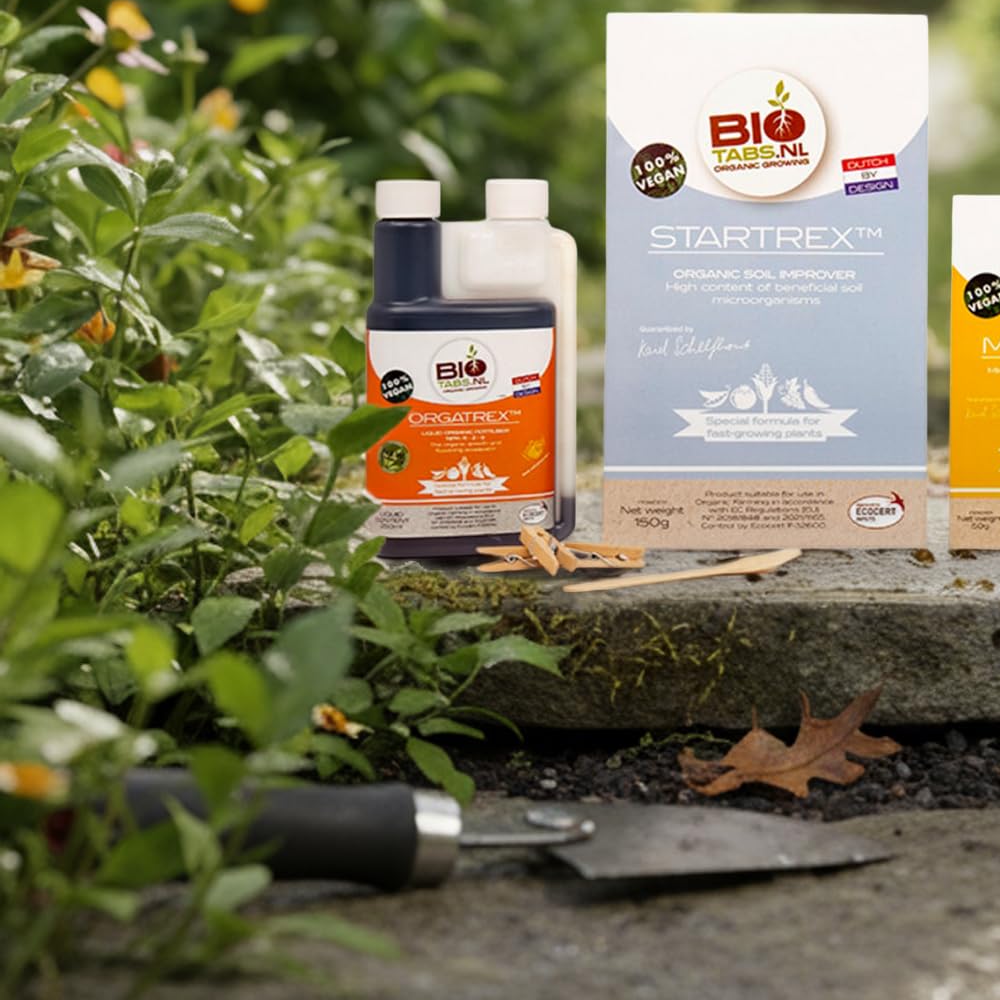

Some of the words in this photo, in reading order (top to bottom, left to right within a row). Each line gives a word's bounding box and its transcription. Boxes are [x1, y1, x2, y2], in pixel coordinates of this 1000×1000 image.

[709, 109, 805, 147] BIO
[712, 143, 808, 163] TABS.NL
[634, 151, 679, 173] 100%
[713, 163, 760, 172] ORGANIC
[762, 159, 809, 169] GROWING
[846, 157, 888, 169] DUTCH
[636, 164, 685, 191] VEGAN
[861, 171, 877, 179] BY
[848, 180, 894, 193] DESIGN
[673, 270, 741, 279] ORGANIC
[744, 270, 775, 279] SOIL
[780, 270, 856, 279] IMPROVER
[665, 282, 697, 293] High
[701, 284, 753, 293] content
[756, 282, 771, 293] of
[775, 282, 837, 293] beneficial
[841, 283, 862, 293] soil
[712, 295, 820, 306] microorganisms
[436, 359, 487, 381] BIO
[383, 383, 413, 399] VEGAN
[706, 416, 750, 427] Special
[752, 416, 800, 426] formula
[803, 416, 821, 426] for
[706, 429, 782, 439] fast-growing
[785, 429, 822, 439] plants
[620, 505, 641, 514] Net
[644, 505, 684, 516] weight
[855, 507, 897, 516] ECOCERT
[635, 517, 669, 530] 150g
